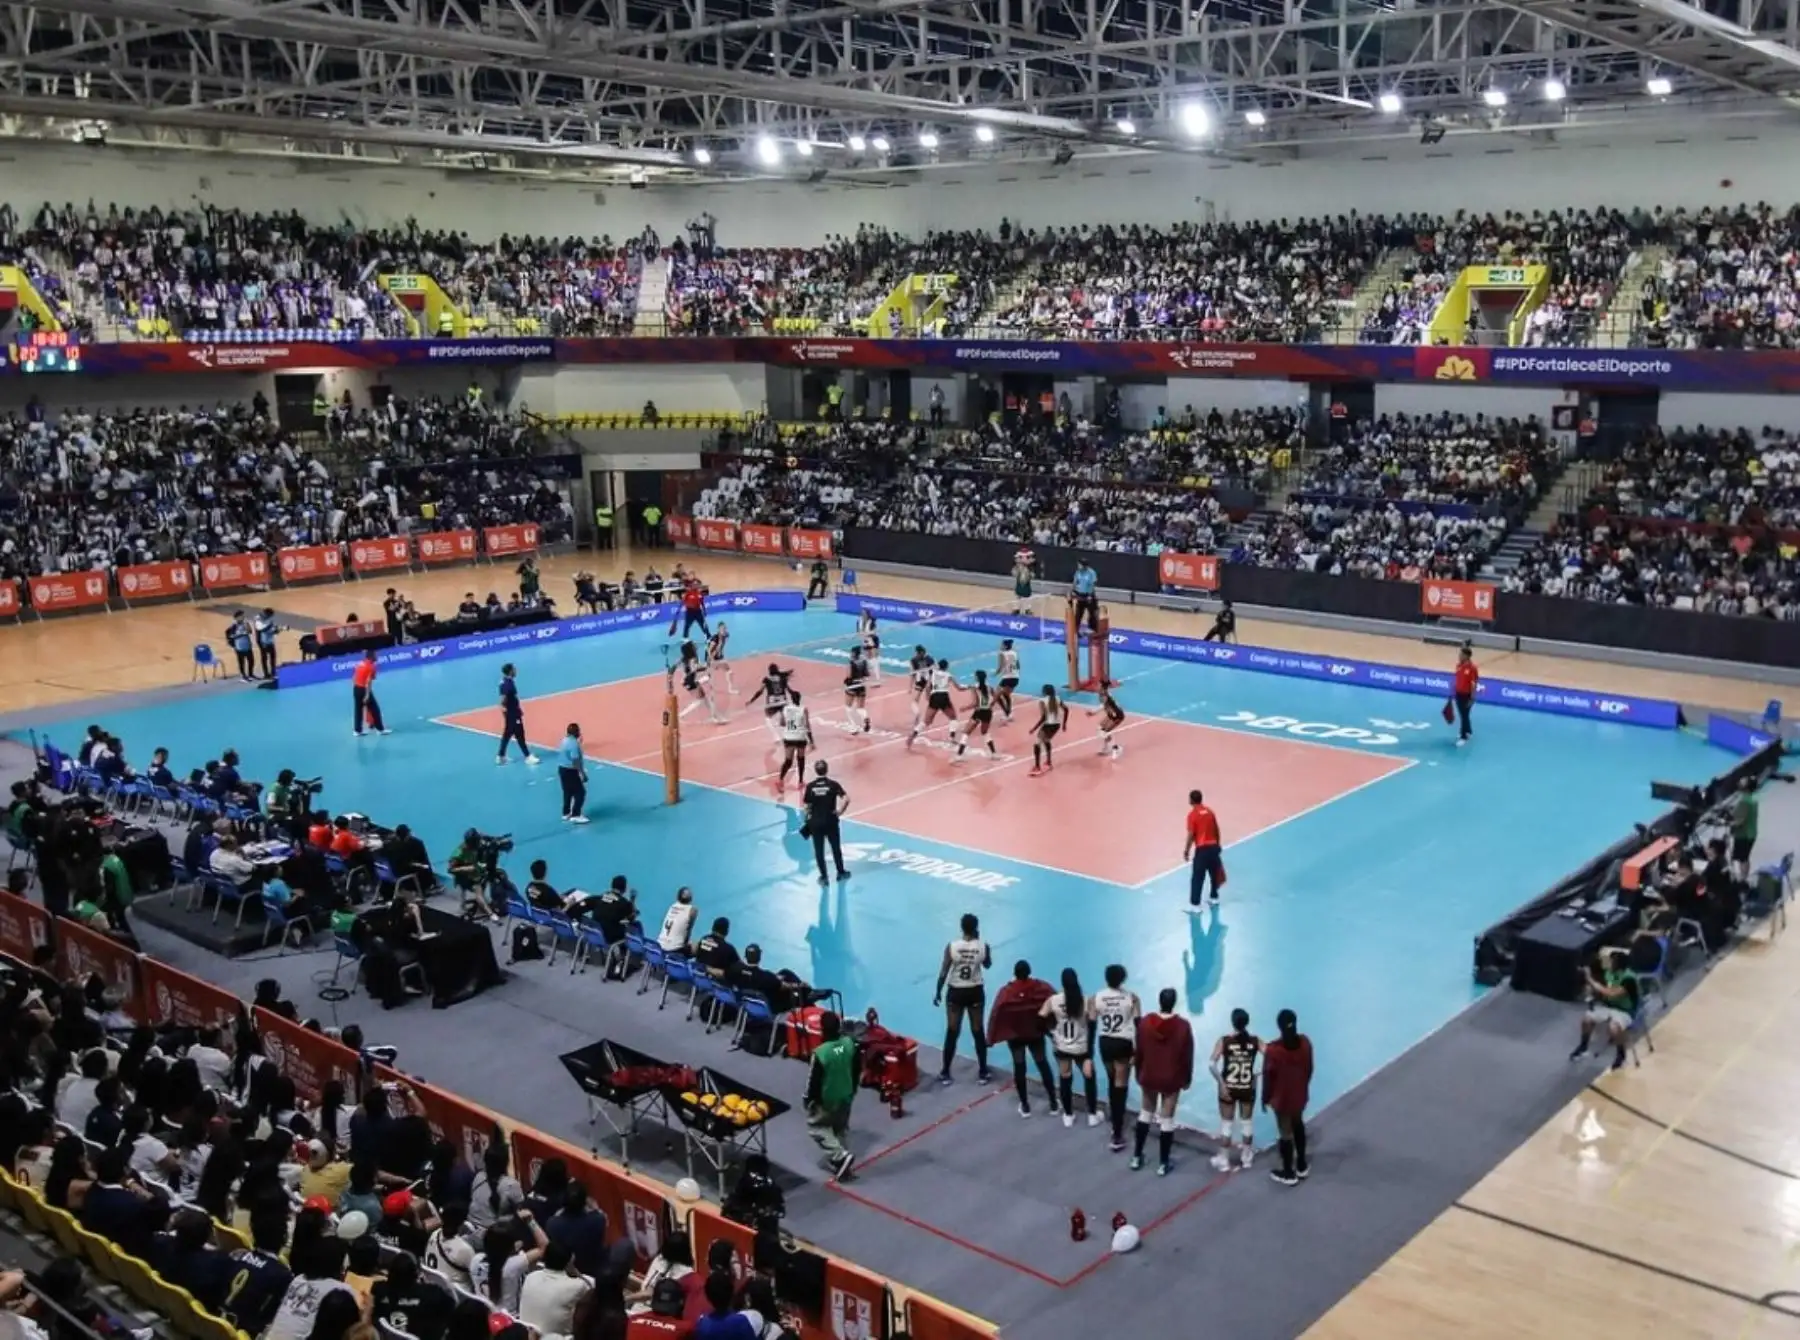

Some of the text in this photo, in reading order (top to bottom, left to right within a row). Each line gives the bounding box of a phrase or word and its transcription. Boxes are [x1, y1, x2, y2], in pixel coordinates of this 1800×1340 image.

[1494, 357, 1672, 377] #IPDFortaleceElDeporte
[536, 627, 558, 639] BCP
[420, 645, 443, 658] BCP
[1213, 648, 1236, 659] BCP
[1331, 663, 1354, 675] BCP
[1501, 687, 1537, 702] Contigo
[1600, 700, 1630, 713] BCP
[1242, 713, 1378, 741] BCP
[665, 920, 674, 936] 4
[960, 966, 971, 980] 8
[1064, 1021, 1075, 1039] 11
[1102, 1014, 1123, 1033] 92
[1226, 1062, 1252, 1083] 25
